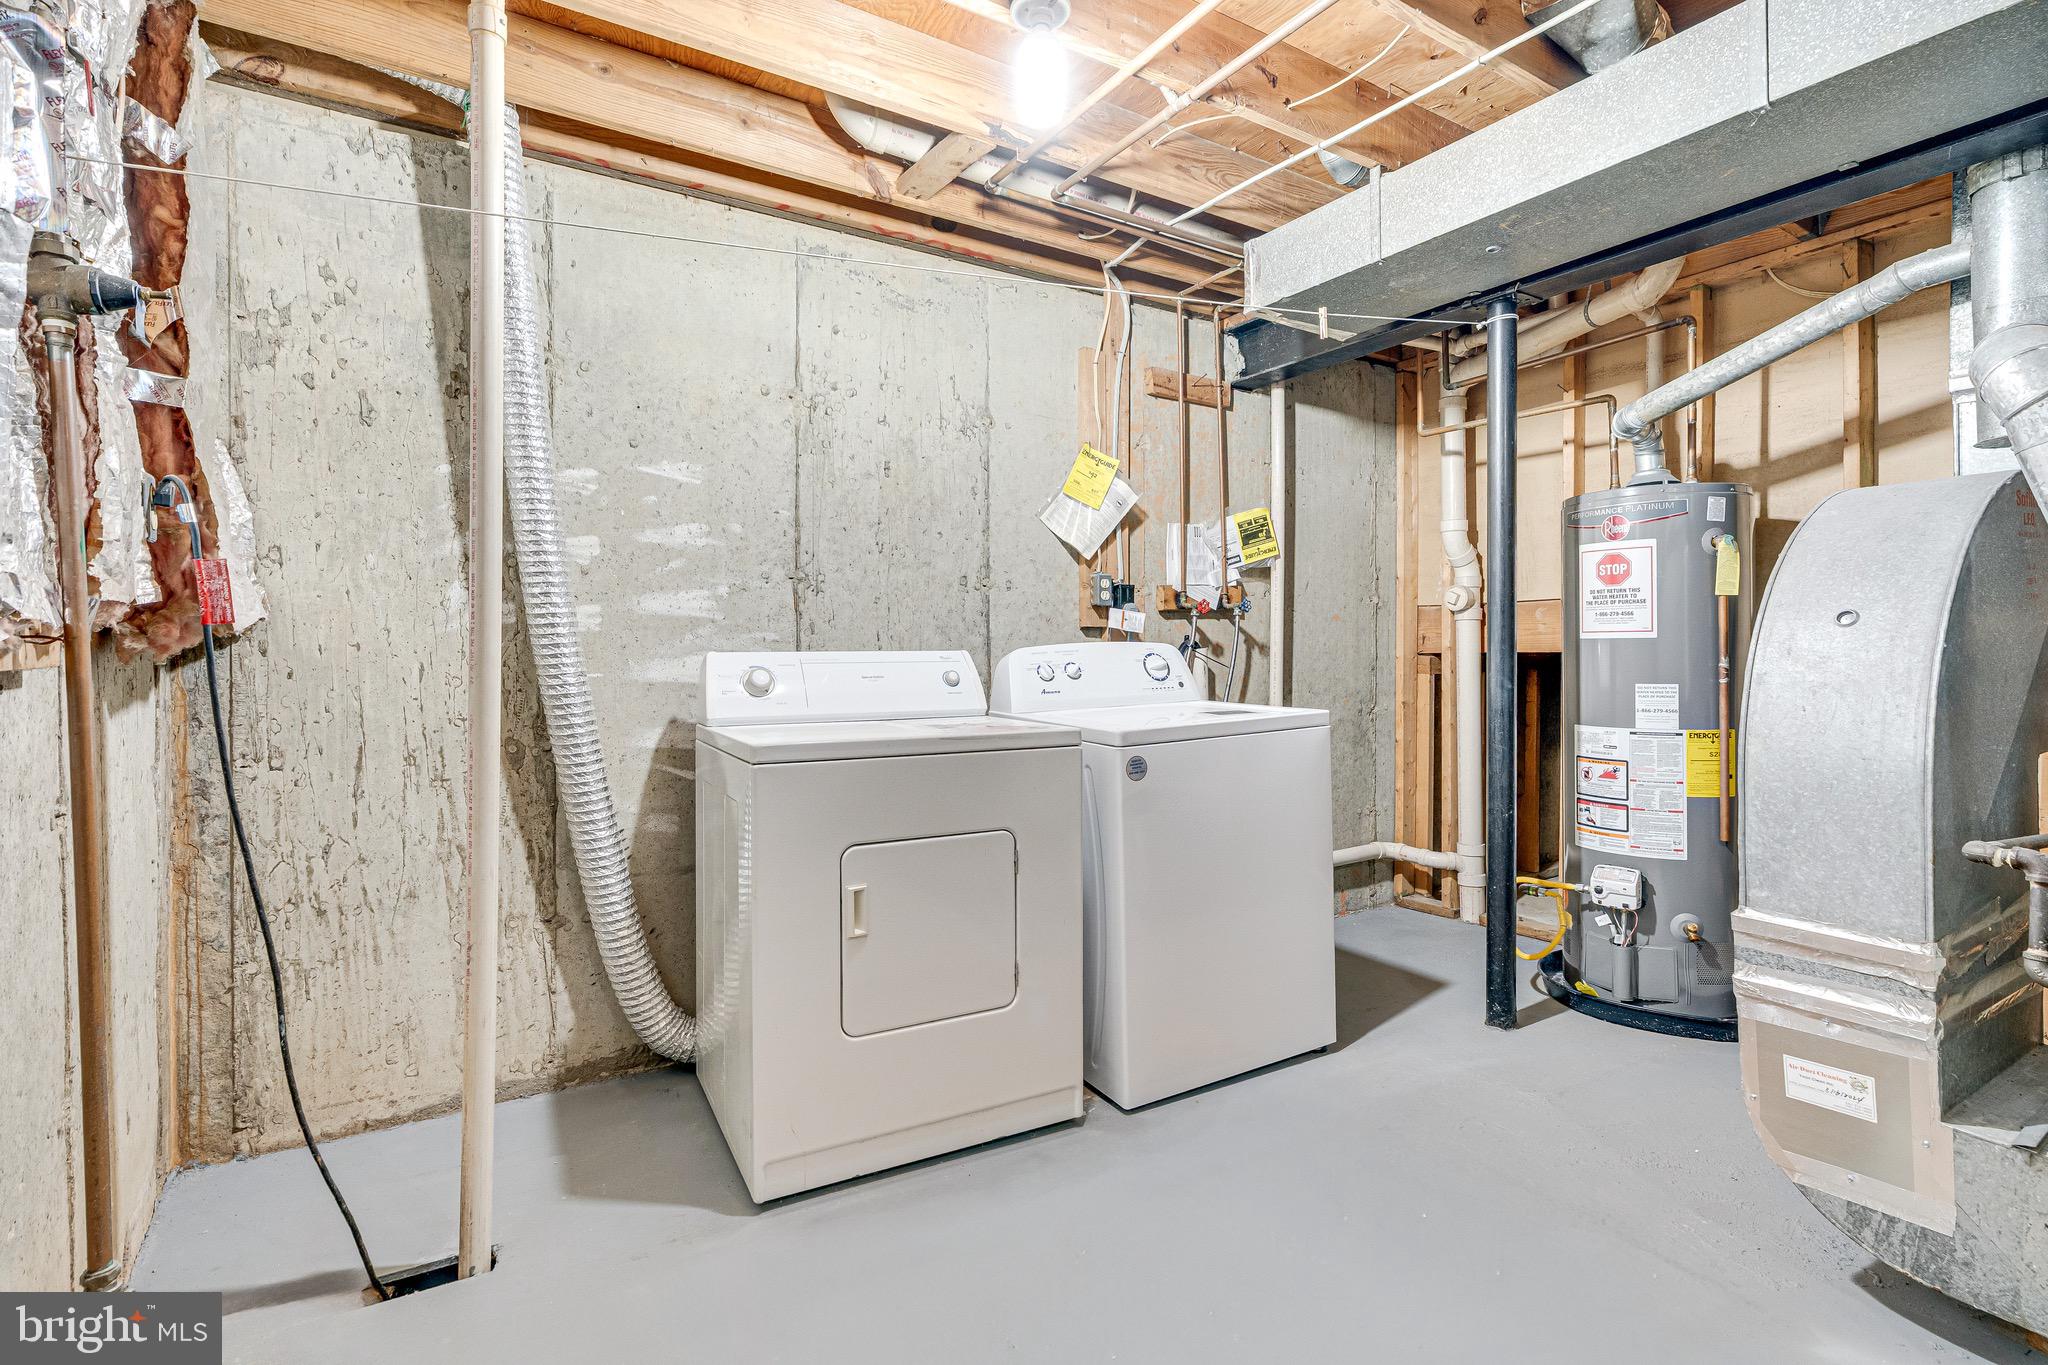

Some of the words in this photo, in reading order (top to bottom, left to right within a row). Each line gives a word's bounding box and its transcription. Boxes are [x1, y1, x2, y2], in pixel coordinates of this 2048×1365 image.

[1571, 507, 1623, 520] PERFORMANCE
[1625, 502, 1675, 513] PLATINUM
[1599, 563, 1628, 576] STOP
[1799, 1065, 1816, 1075] Duct
[1816, 1070, 1848, 1085] Cleaning
